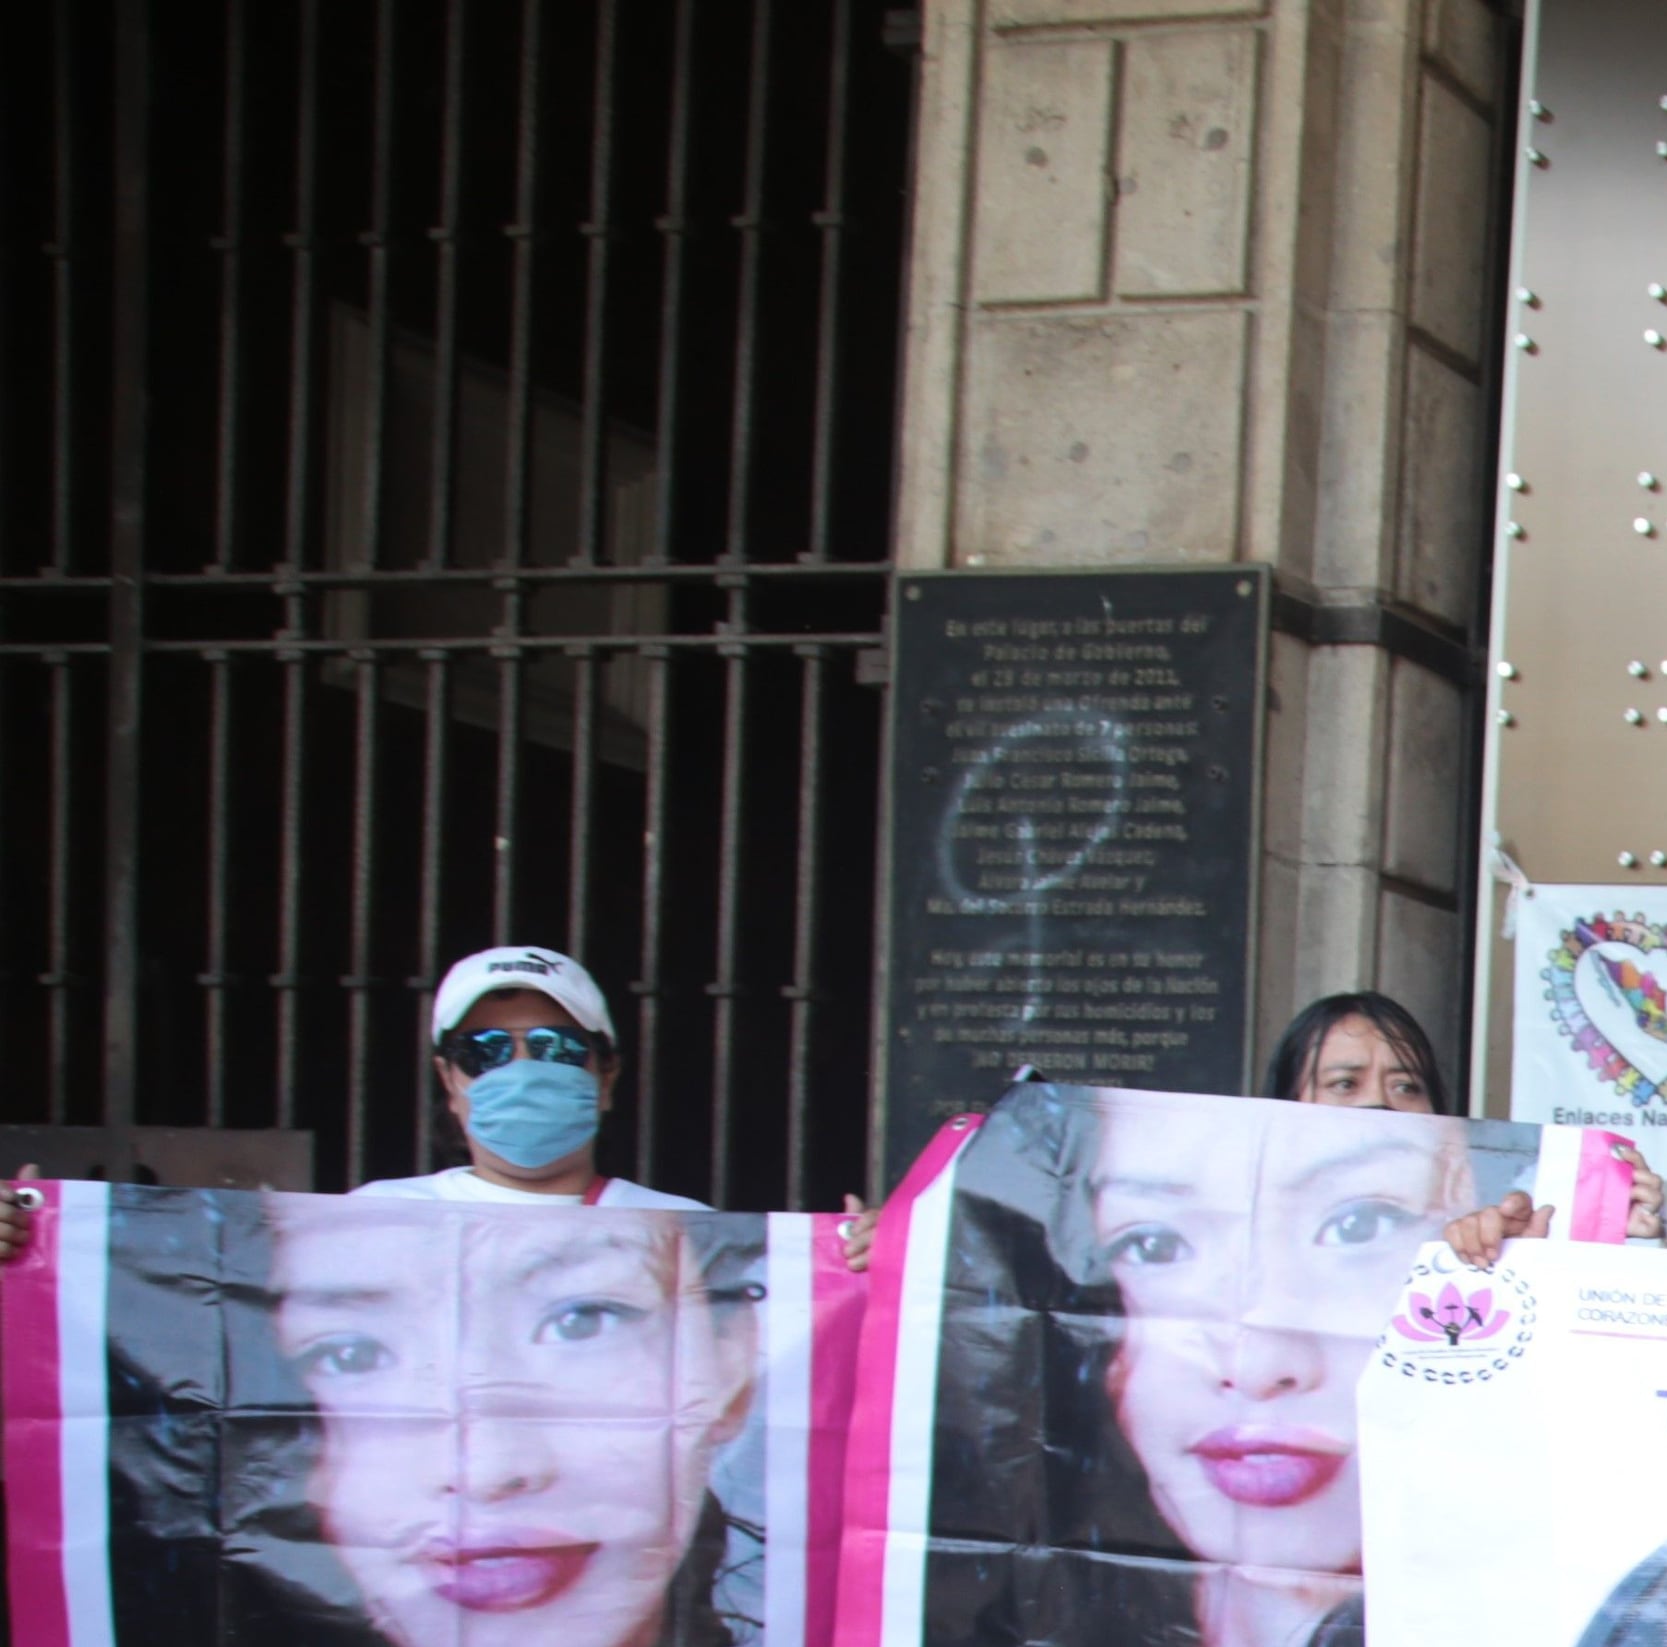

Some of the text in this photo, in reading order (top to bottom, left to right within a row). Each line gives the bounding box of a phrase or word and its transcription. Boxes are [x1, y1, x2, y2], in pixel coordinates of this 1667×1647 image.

[1552, 1107, 1634, 1128] Enlaces
[1579, 1287, 1636, 1305] UNIÓN
[1643, 1292, 1666, 1308] DE
